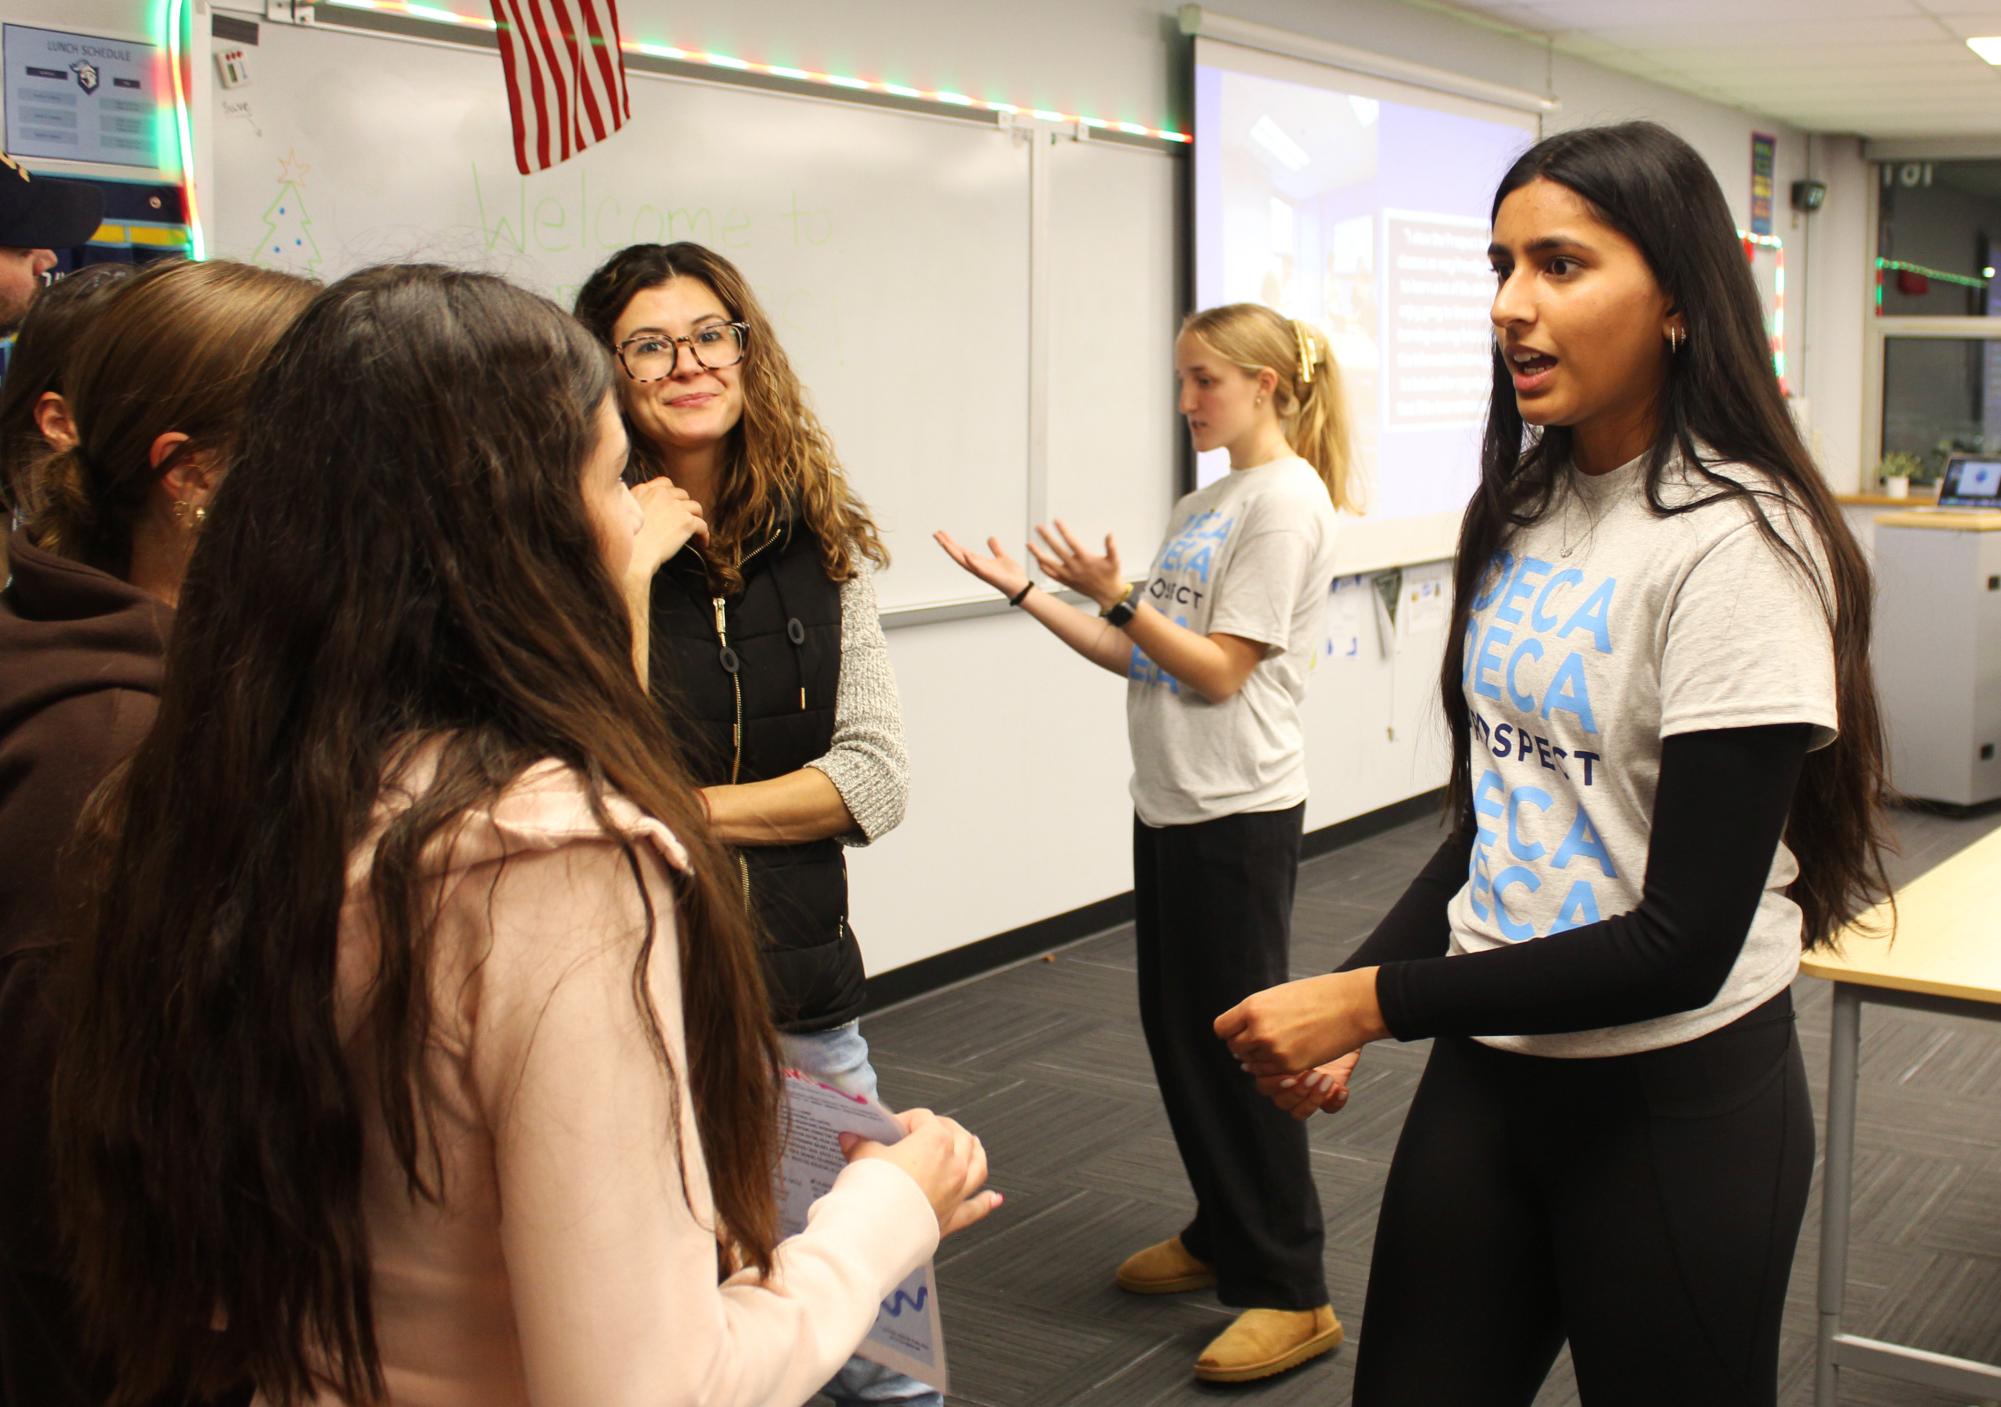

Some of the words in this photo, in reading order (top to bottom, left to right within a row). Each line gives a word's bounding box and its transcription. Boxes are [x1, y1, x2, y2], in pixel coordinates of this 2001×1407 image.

[47, 40, 79, 54] LUNCH
[81, 45, 131, 61] SCHEDULE
[471, 160, 753, 254] Welcome
[783, 191, 834, 247] to
[1474, 768, 1618, 879] ECA
